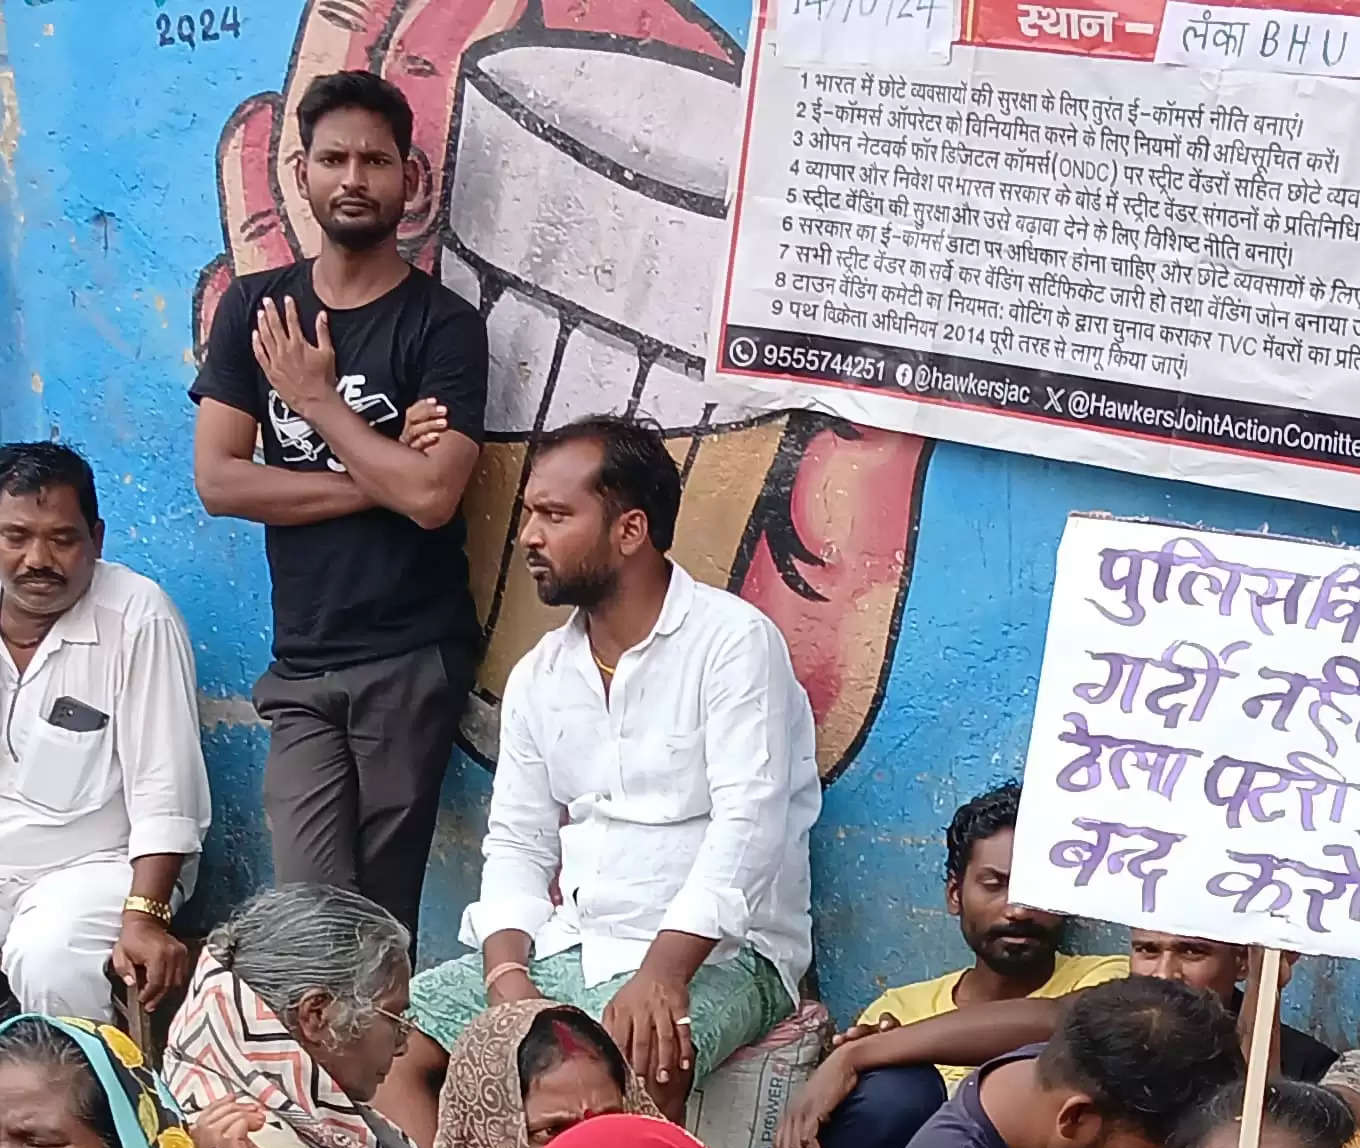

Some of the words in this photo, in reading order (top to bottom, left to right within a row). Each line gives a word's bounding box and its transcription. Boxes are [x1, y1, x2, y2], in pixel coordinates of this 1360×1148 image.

[1182, 9, 1250, 57] लंका
[1259, 19, 1348, 67] BHU
[796, 101, 807, 119] 2
[887, 105, 943, 133] ऑपरेटर
[945, 110, 963, 134] को
[965, 111, 1042, 143] विनियमित
[1044, 122, 1079, 148] करने
[1082, 124, 1097, 148] के
[1100, 125, 1130, 157] लिए
[1133, 129, 1183, 159] नियमों
[1186, 134, 1212, 162] की
[1213, 139, 1303, 171] अधिसूचित
[799, 71, 810, 91] 1
[815, 73, 857, 95] भारत
[860, 71, 875, 97] में
[878, 74, 908, 99] छोटे
[910, 80, 968, 105] व्यवसायों
[970, 82, 994, 108] की
[997, 90, 1038, 116] सुरक्षा
[1041, 88, 1056, 113] के
[1059, 89, 1090, 121] लिए
[1092, 95, 1124, 126] तुरंत
[1209, 104, 1250, 133] नीति
[789, 159, 800, 176] 4
[805, 160, 856, 183] व्यापार
[859, 161, 890, 186] और
[893, 164, 934, 192] निवेश
[999, 182, 1052, 205] सरकार
[1054, 182, 1073, 207] के
[1075, 185, 1102, 212] बोर्ड
[1105, 188, 1120, 215] में
[1122, 191, 1161, 223] स्ट्रीट
[1163, 198, 1199, 224] वेंडर
[1200, 202, 1260, 232] संगठनों
[1263, 207, 1282, 233] के
[792, 130, 804, 147] 3
[808, 126, 853, 153] ओपन
[857, 130, 908, 159] नेटवर्क
[911, 137, 939, 162] फॉर
[1123, 165, 1145, 186] पर
[1148, 163, 1185, 191] स्ट्रीट
[1188, 166, 1231, 196] वेंडरों
[1234, 173, 1284, 201] सहित
[1287, 177, 1323, 205] छोटे
[782, 215, 793, 232] 6
[798, 216, 853, 240] सरकार
[856, 223, 878, 244] का
[945, 234, 981, 257] डाटा
[983, 239, 1004, 261] पर
[1006, 239, 1069, 267] अधिकार
[1071, 246, 1108, 274] होना
[1110, 253, 1157, 284] चाहिए
[1160, 258, 1194, 285] और
[1197, 260, 1230, 289] छोटे
[1233, 271, 1305, 300] व्यवसायों
[1309, 276, 1327, 301] के
[785, 187, 797, 204] 5
[802, 184, 842, 214] स्ट्रीट
[845, 187, 885, 216] वेंडिंग
[888, 193, 910, 218] की
[913, 202, 951, 230] सुरक्षा
[951, 201, 981, 227] और
[983, 206, 1012, 231] उसे
[1063, 214, 1090, 241] देने
[1093, 217, 1109, 243] के
[1111, 219, 1141, 251] लिए
[1144, 223, 1201, 254] विशिष्ट
[1203, 232, 1241, 261] नीति
[763, 344, 886, 382] 9555744251
[914, 363, 1031, 406] @hawkersjac
[1048, 817, 1189, 913] बन्द
